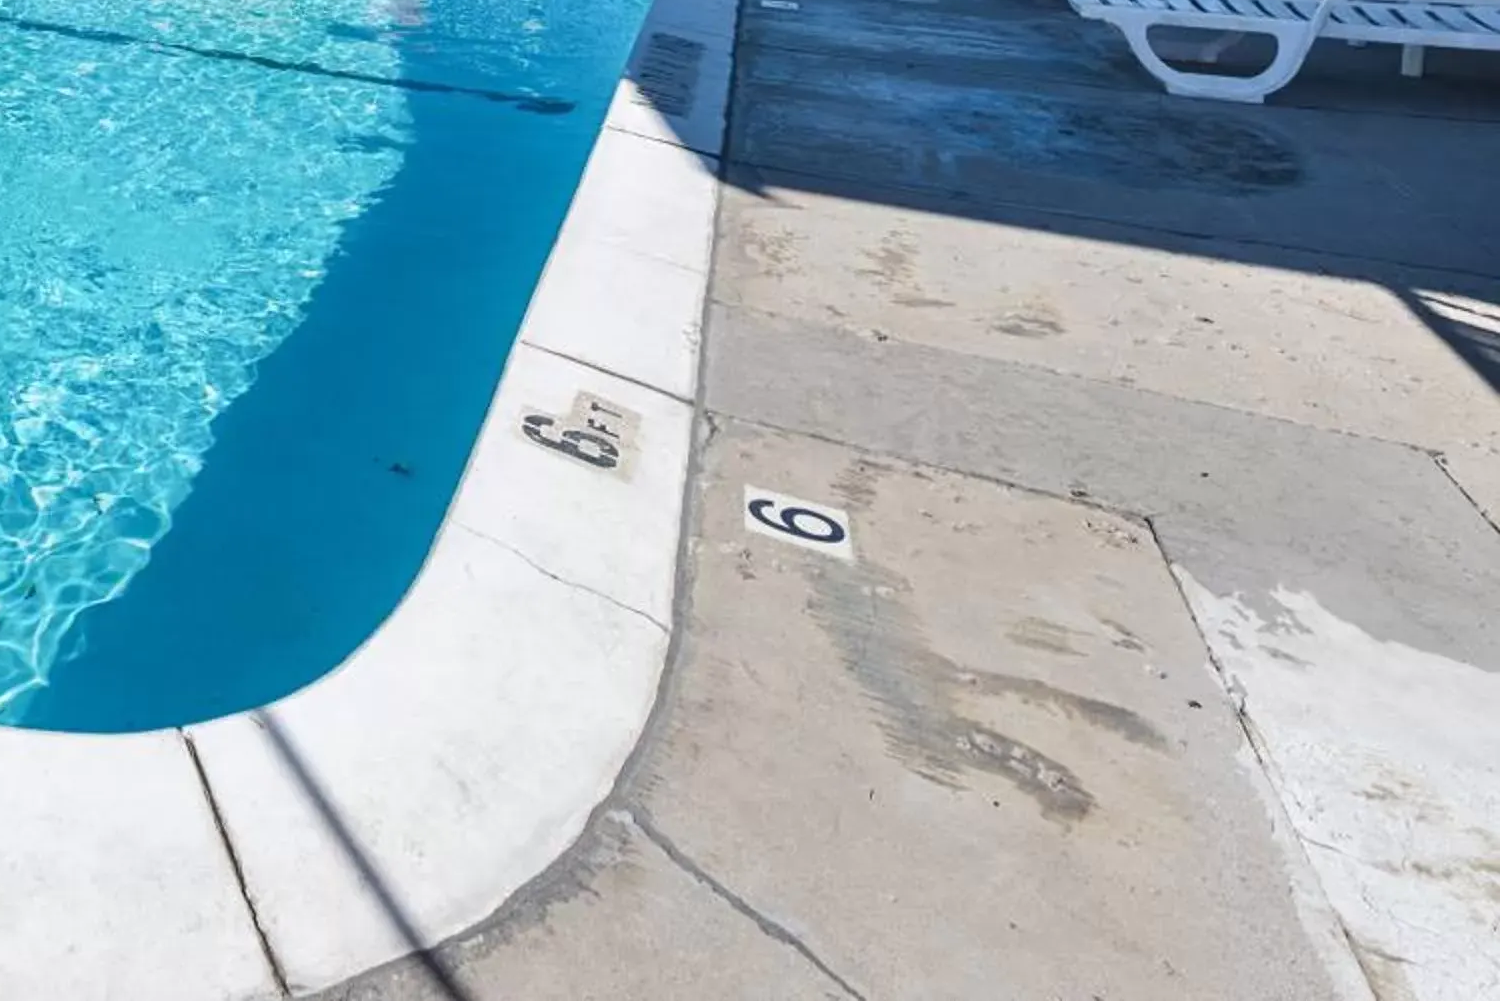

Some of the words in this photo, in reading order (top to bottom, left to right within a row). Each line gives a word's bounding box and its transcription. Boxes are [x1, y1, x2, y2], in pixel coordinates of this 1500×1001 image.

[522, 413, 620, 469] 6
[586, 401, 623, 439] FT
[747, 498, 846, 544] 6
